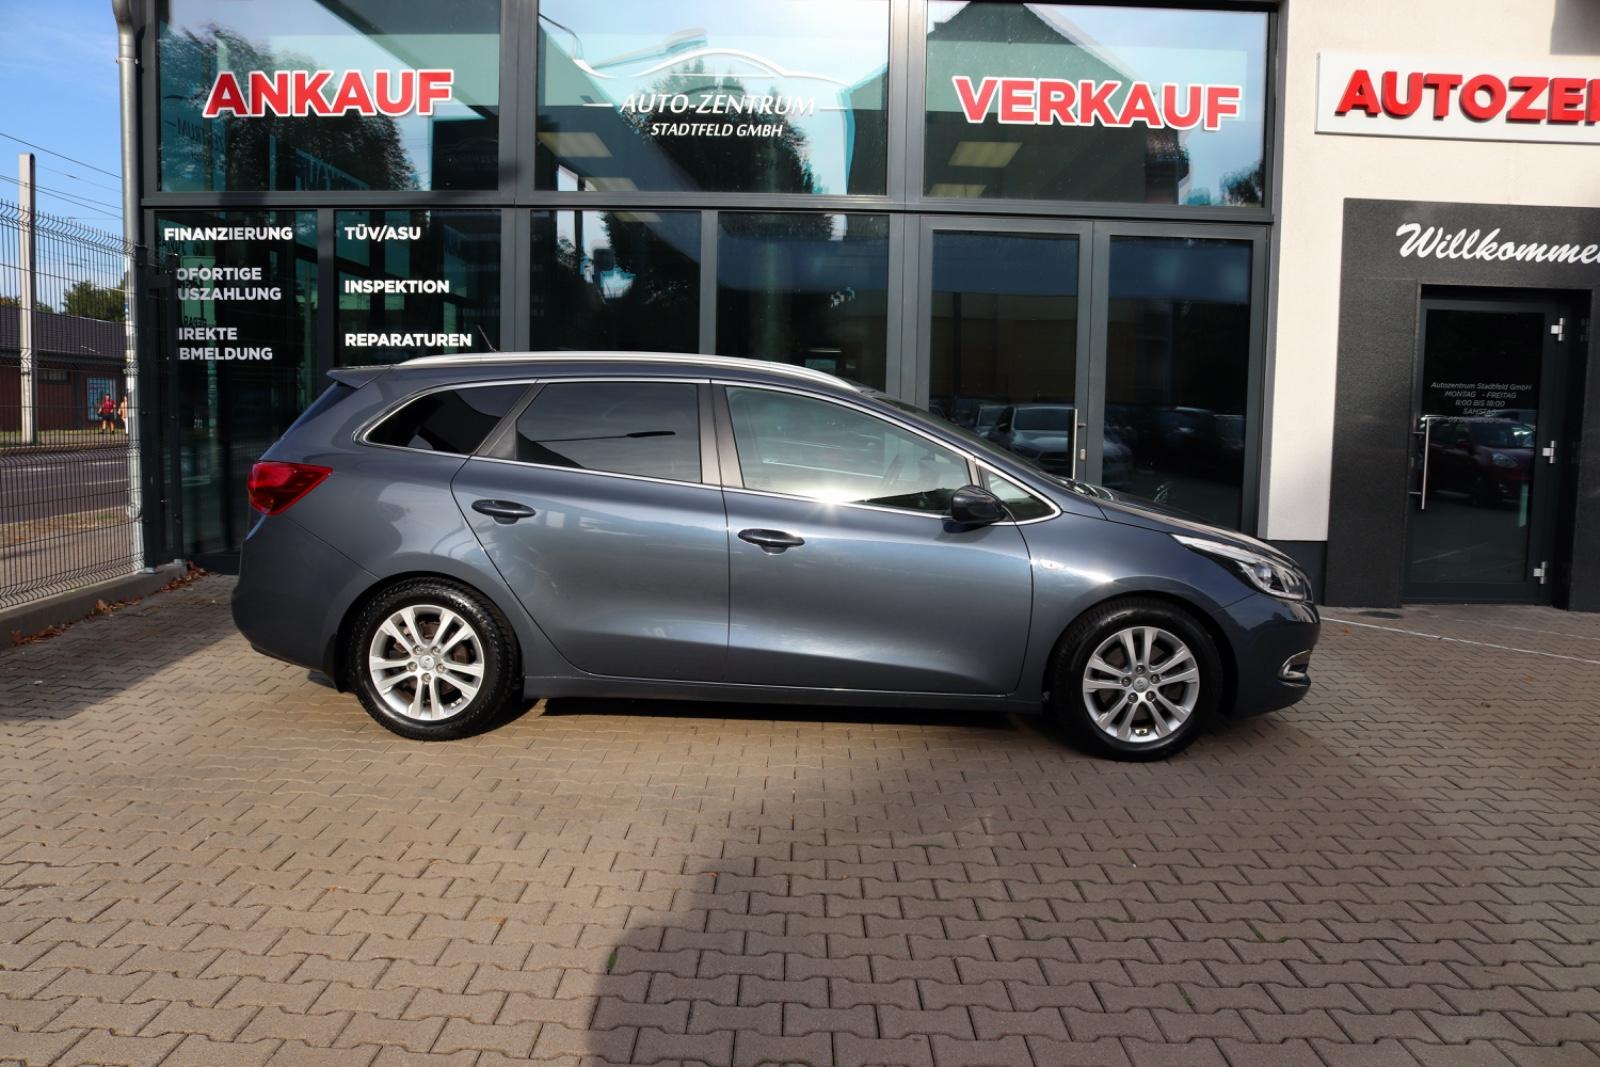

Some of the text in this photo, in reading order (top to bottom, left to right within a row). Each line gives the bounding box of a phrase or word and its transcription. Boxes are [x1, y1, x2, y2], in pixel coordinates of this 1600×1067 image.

[203, 69, 454, 117] ANKAUF
[1334, 69, 1600, 126] AUTOZE
[620, 94, 815, 115] AUTO-ZENTRUM
[952, 76, 1242, 131] VERKAUF
[650, 122, 783, 138] STADTFELD GMBH
[163, 227, 294, 241] FINANZIERUNG
[344, 223, 421, 242] TÜV/ASU
[1395, 222, 1600, 265] Willkomme
[176, 267, 262, 281] OFORTIGE
[177, 287, 282, 301] USZAHLUNG
[344, 280, 450, 294] INSPEKTION
[178, 327, 238, 341] IREKTE
[344, 333, 472, 347] REPARATUREN
[179, 347, 273, 361] BMELDUNG
[1486, 391, 1517, 399] FREITAG
